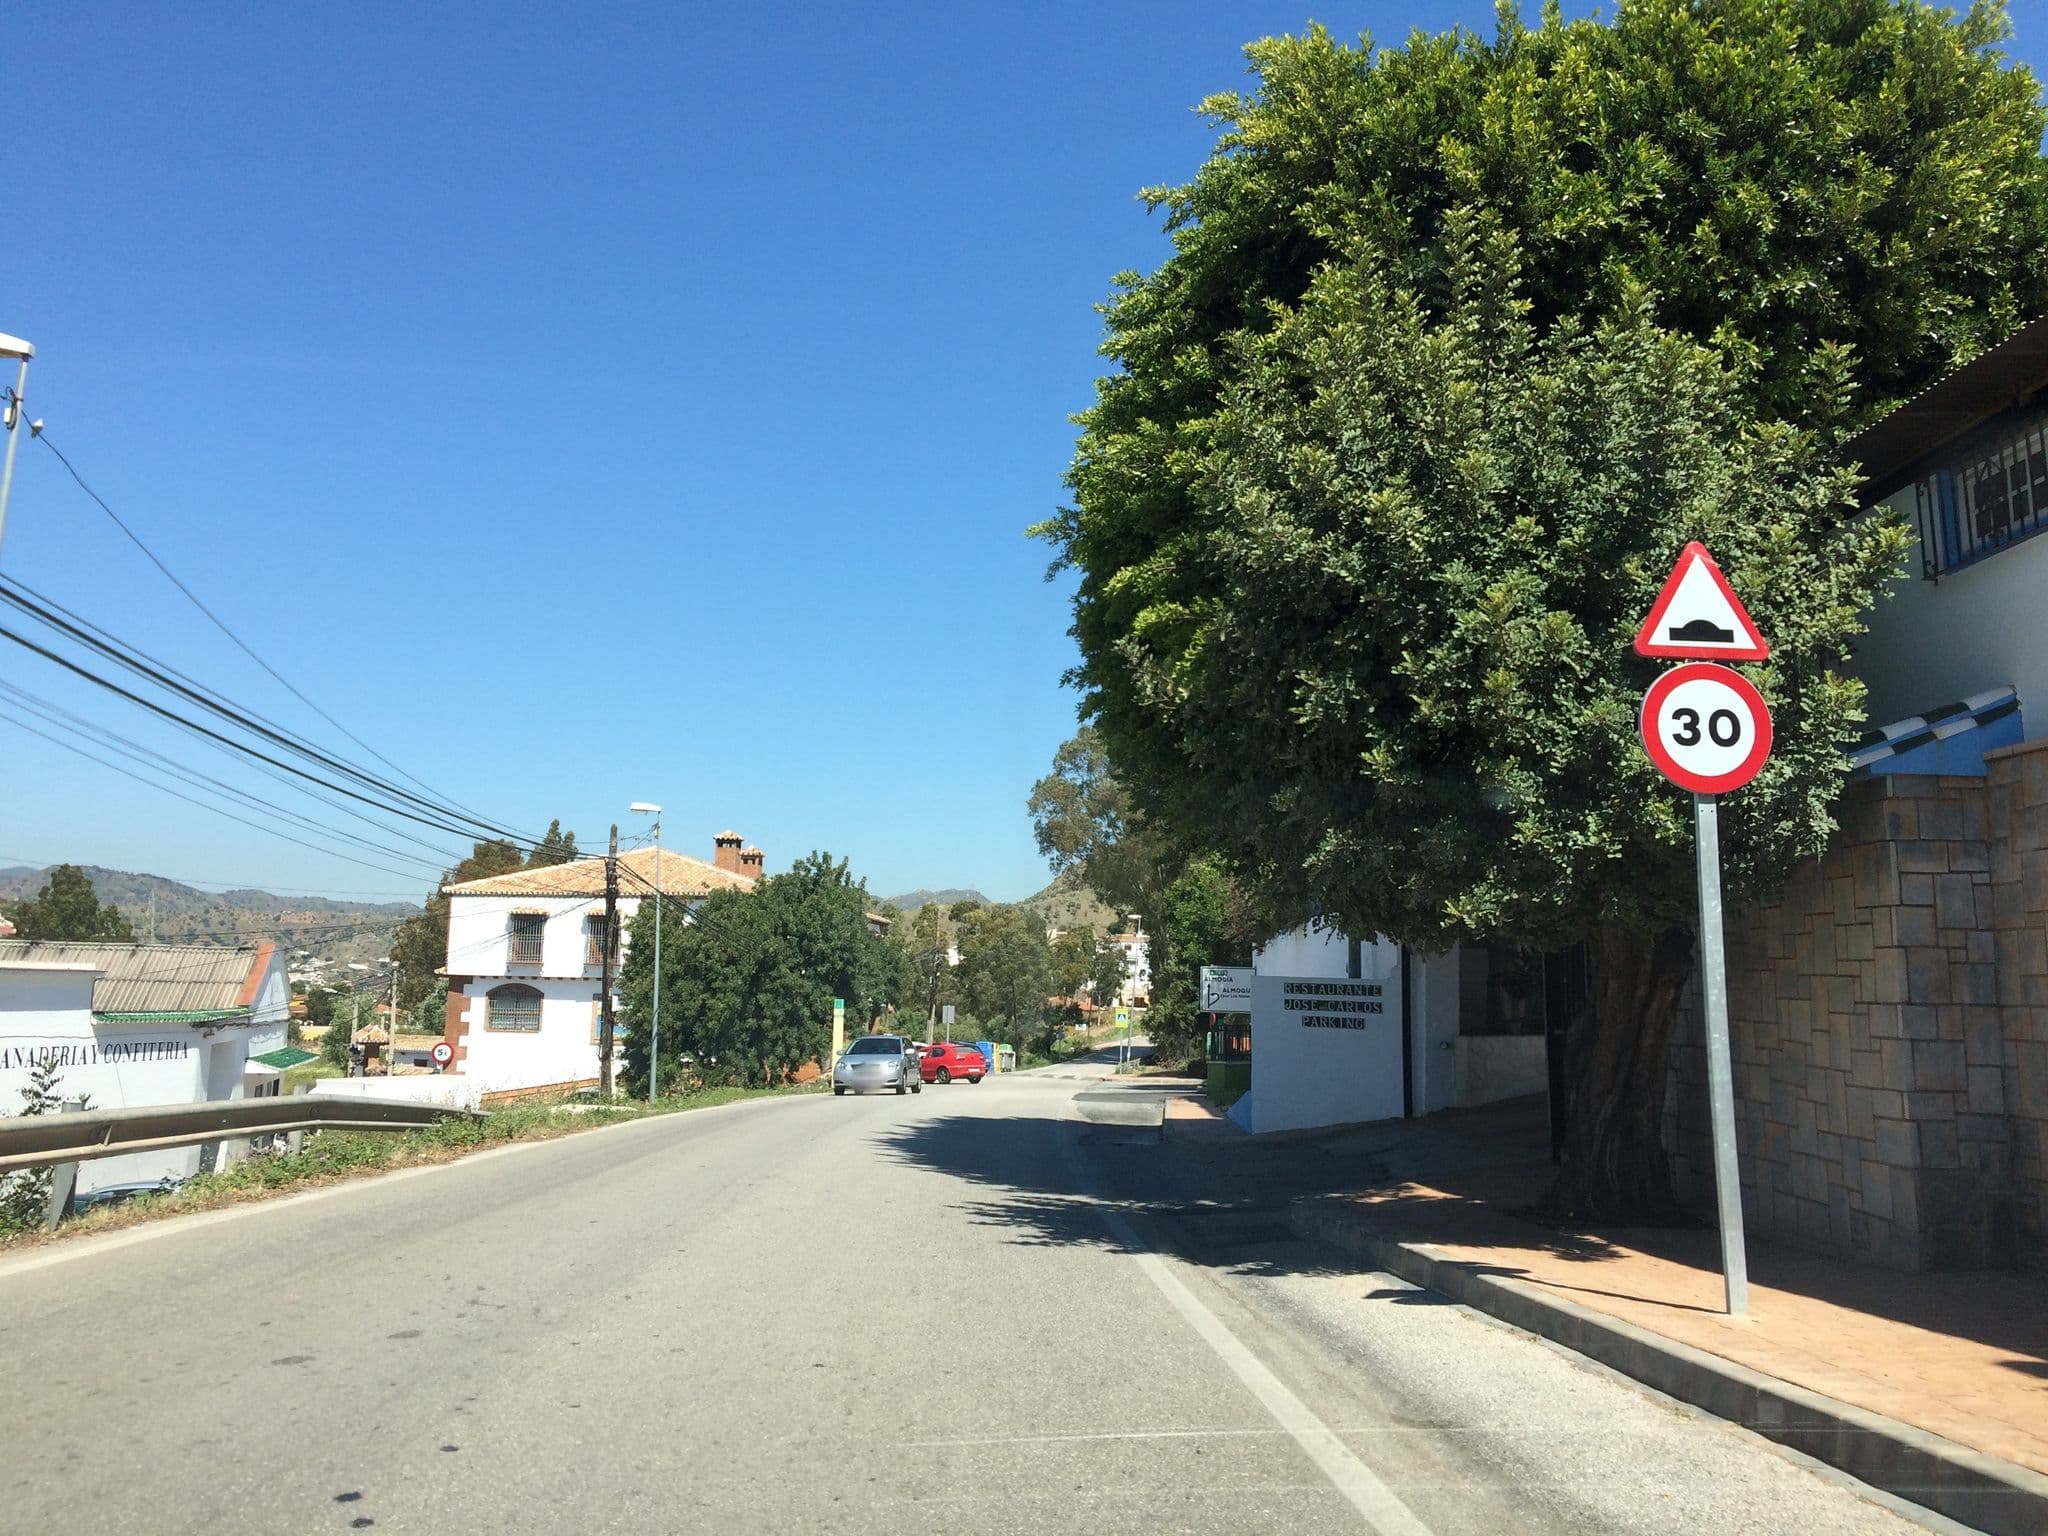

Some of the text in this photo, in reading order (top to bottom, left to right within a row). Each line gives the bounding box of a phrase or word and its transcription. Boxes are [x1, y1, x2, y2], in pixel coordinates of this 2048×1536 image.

[1671, 707, 1741, 747] 30
[1284, 983, 1381, 996] RESTAURANTE
[1285, 1000, 1381, 1013] JOSE CARLOS
[1303, 1016, 1363, 1029] PARKING
[104, 1041, 188, 1064] CONFITERIA
